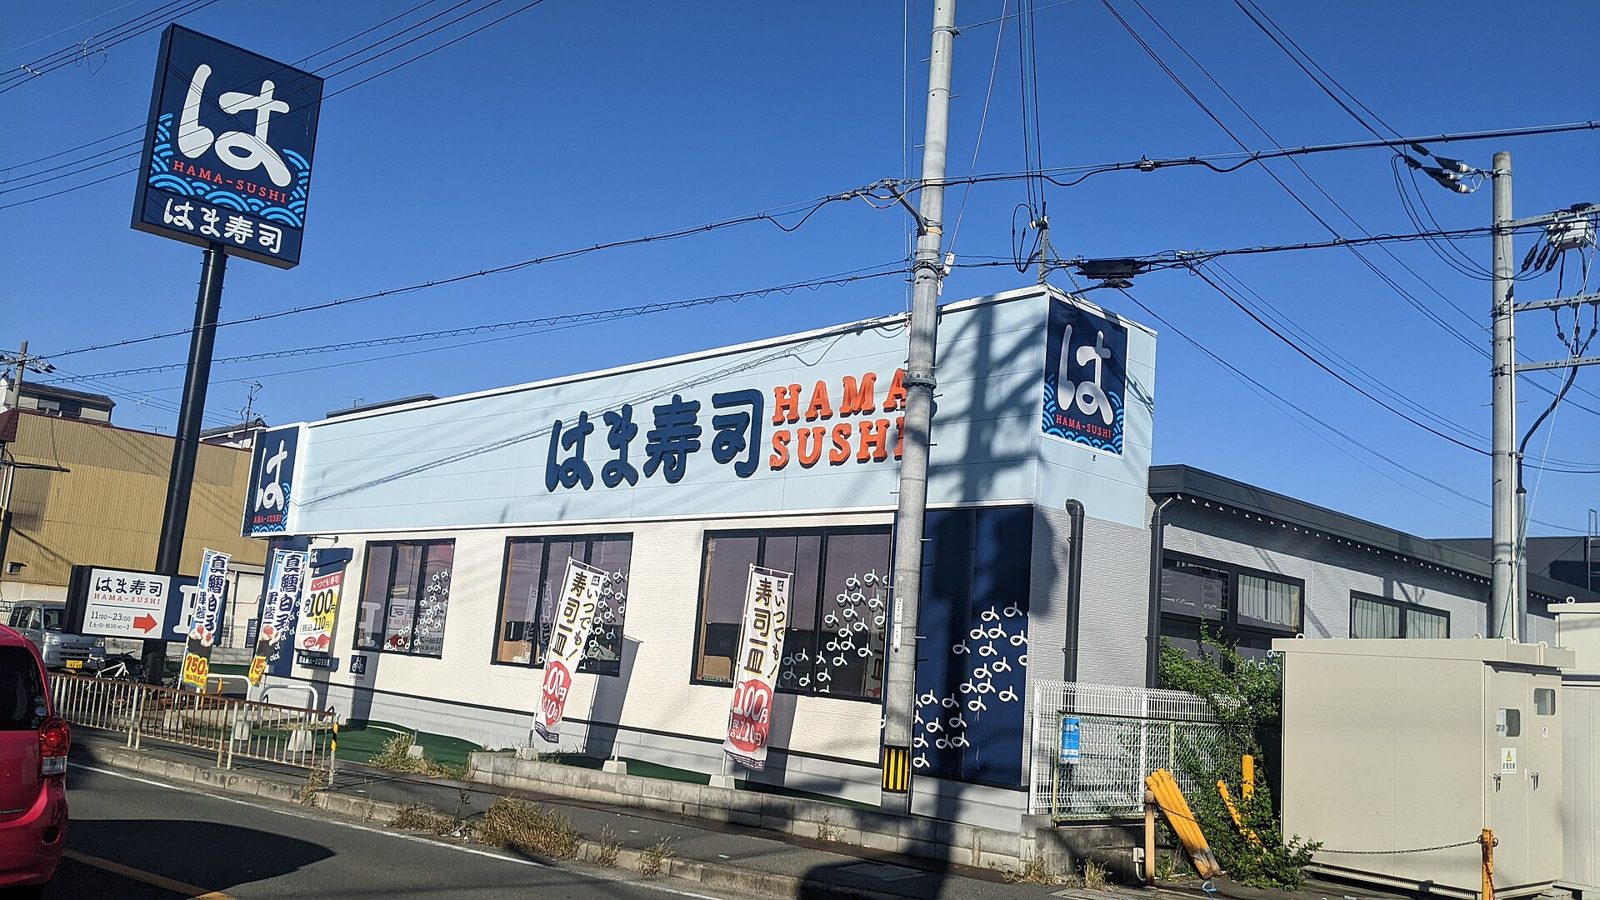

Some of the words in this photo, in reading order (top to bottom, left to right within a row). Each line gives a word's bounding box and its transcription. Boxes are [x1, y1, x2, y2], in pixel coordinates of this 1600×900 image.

[178, 64, 292, 188] は
[172, 159, 288, 204] HAMA-SUSHI
[163, 197, 283, 254] はま寿司
[772, 367, 907, 427] HAMA
[1057, 324, 1114, 425] は
[545, 387, 764, 493] はま寿司
[1055, 414, 1112, 439] HAMA-SUSHI
[254, 439, 288, 513] は
[93, 592, 161, 605] HAMA-SUSHI
[95, 576, 163, 597] はま寿司
[552, 571, 588, 657] 寿司一皿
[743, 577, 772, 675] 寿司一皿
